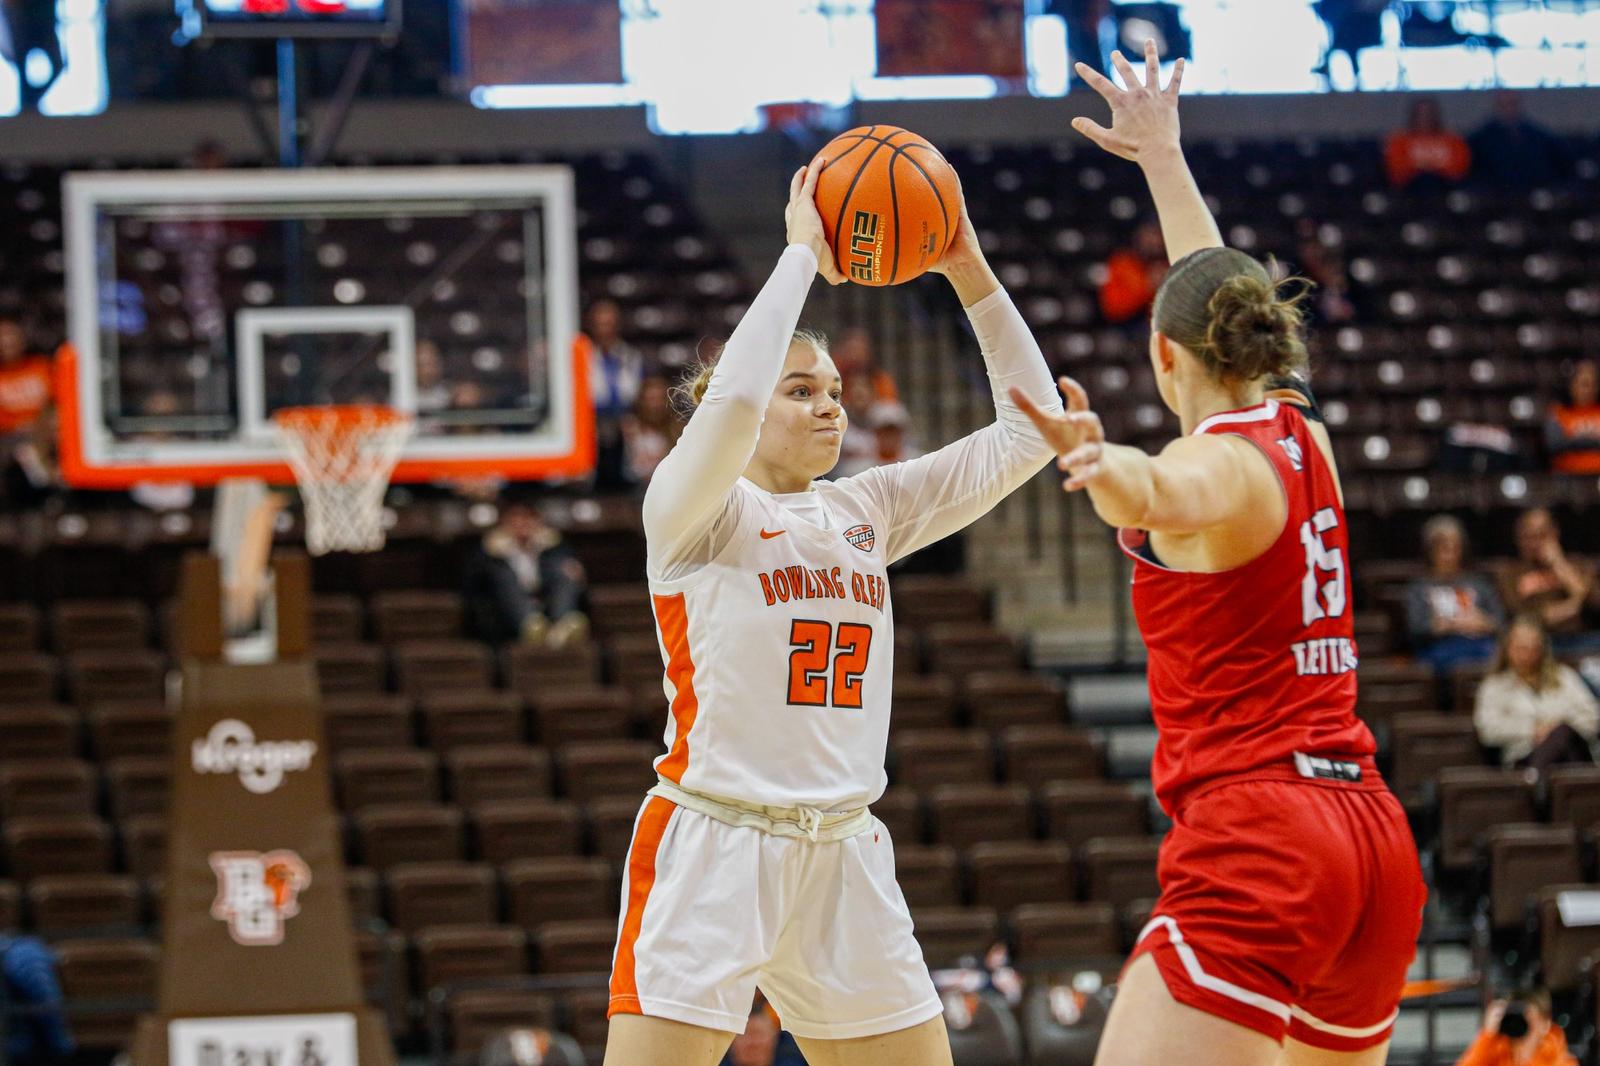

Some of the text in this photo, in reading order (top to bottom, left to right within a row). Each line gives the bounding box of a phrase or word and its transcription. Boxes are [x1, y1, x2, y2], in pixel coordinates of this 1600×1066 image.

[850, 210, 879, 282] ELITE
[847, 530, 875, 545] MAC
[1300, 506, 1346, 628] 15
[758, 565, 846, 607] BOWLING
[786, 618, 873, 709] 22
[191, 718, 318, 794] Kroger
